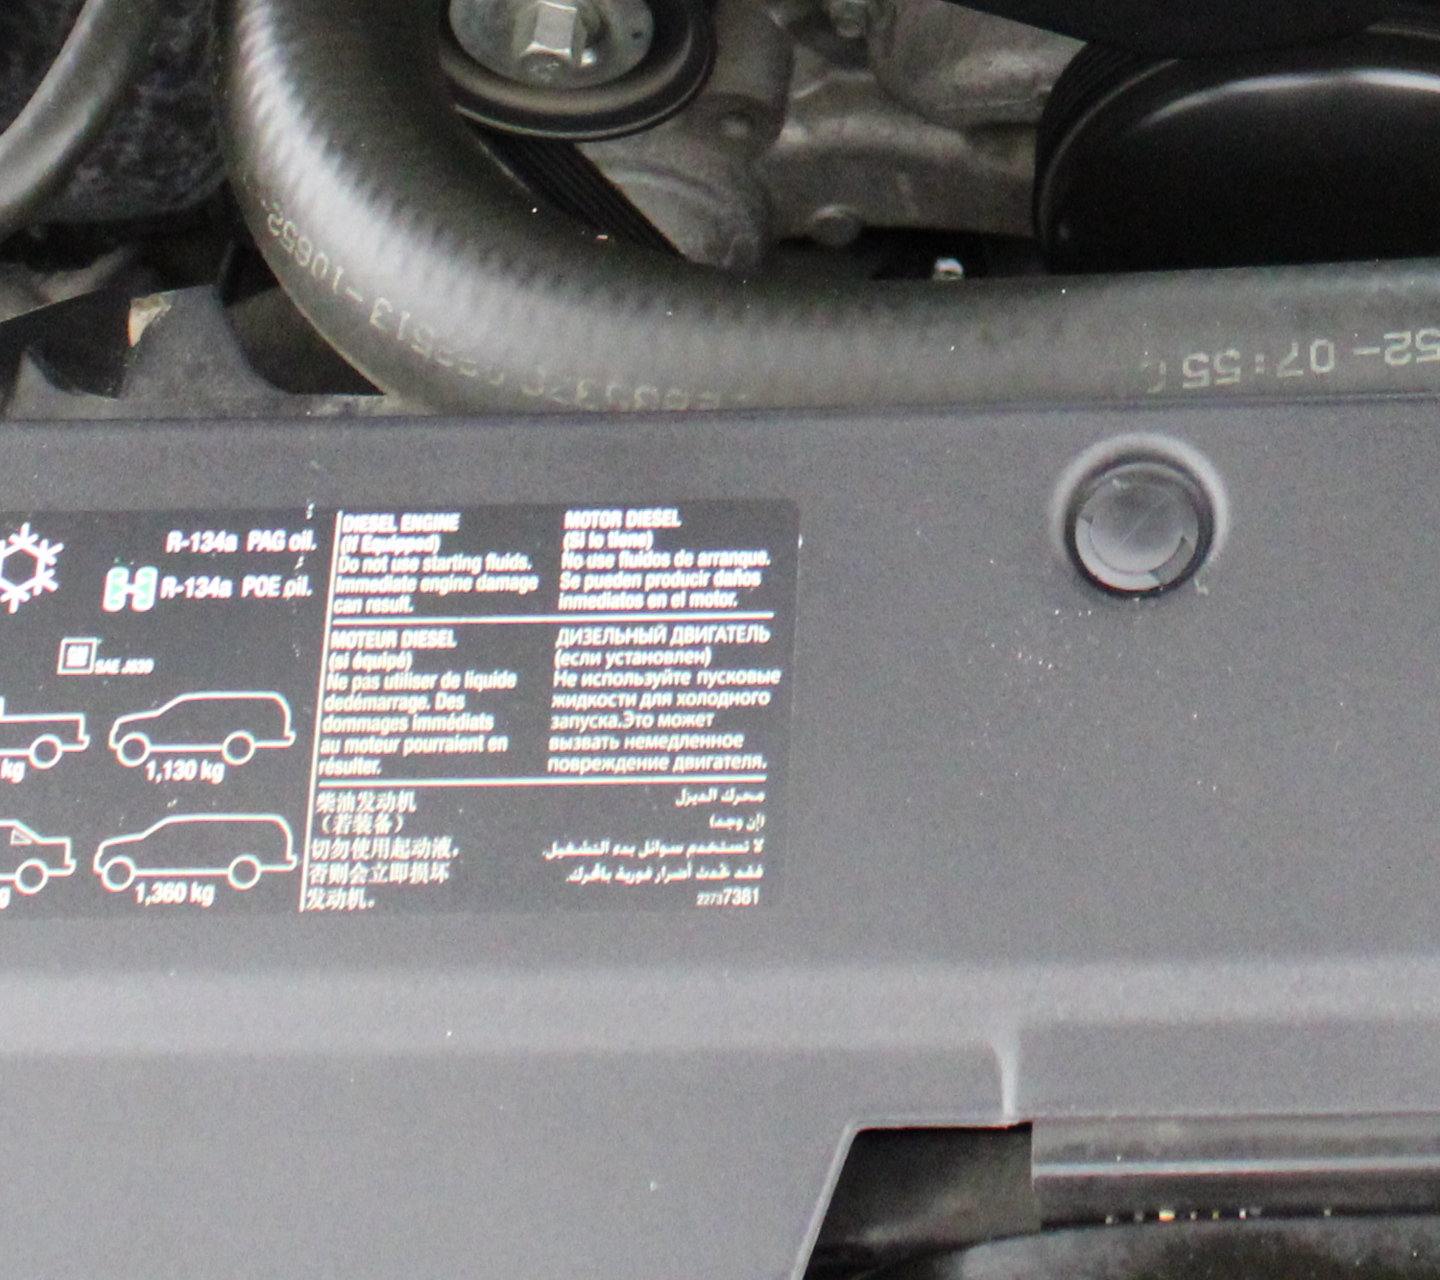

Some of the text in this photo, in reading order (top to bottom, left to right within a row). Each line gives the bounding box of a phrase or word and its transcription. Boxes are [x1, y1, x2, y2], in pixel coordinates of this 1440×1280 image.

[1182, 339, 1336, 389] 07:55
[342, 513, 460, 533] DIESEL ENGINE
[564, 508, 682, 529] MOTOR DIESEL
[166, 529, 317, 553] R-134a PAG oil.
[361, 534, 441, 555] Equipped)
[338, 552, 533, 575] Do not use starting fluids.
[561, 550, 771, 570] No use fluidos de arranque.
[160, 574, 313, 599] R-134a POE oil.
[335, 574, 539, 596] Immediate engine damage
[560, 568, 761, 592] Se pueden producir daños
[333, 595, 413, 614] can result.
[559, 591, 738, 610] inmediatos en el motor.
[330, 630, 457, 650] MOTEUR DIESEL
[555, 625, 770, 648] ДИЗЕЛЬНЫЙ ДВИГАТЕЛЬ
[94, 659, 120, 675] SAE
[554, 646, 712, 669] (если установлен)
[326, 670, 517, 693] Ne pas utiliser de liquide
[553, 668, 781, 690] Не используйте пусковые
[435, 692, 466, 710] Des
[552, 691, 771, 710] жидкости для холодного
[322, 713, 494, 735] dommages immédiats
[658, 713, 714, 728] может
[320, 735, 509, 757] au moteur pourraient en
[549, 735, 745, 751] вызвать немедленное
[0, 760, 26, 783] kg
[146, 760, 225, 784] 1,130 kg
[319, 758, 381, 775] résulter.
[547, 755, 767, 775] повреждение двигателя.
[316, 790, 417, 813] 柴油发动机
[310, 861, 450, 885] 否则会立即损坏
[135, 882, 215, 907] 1,360 kg
